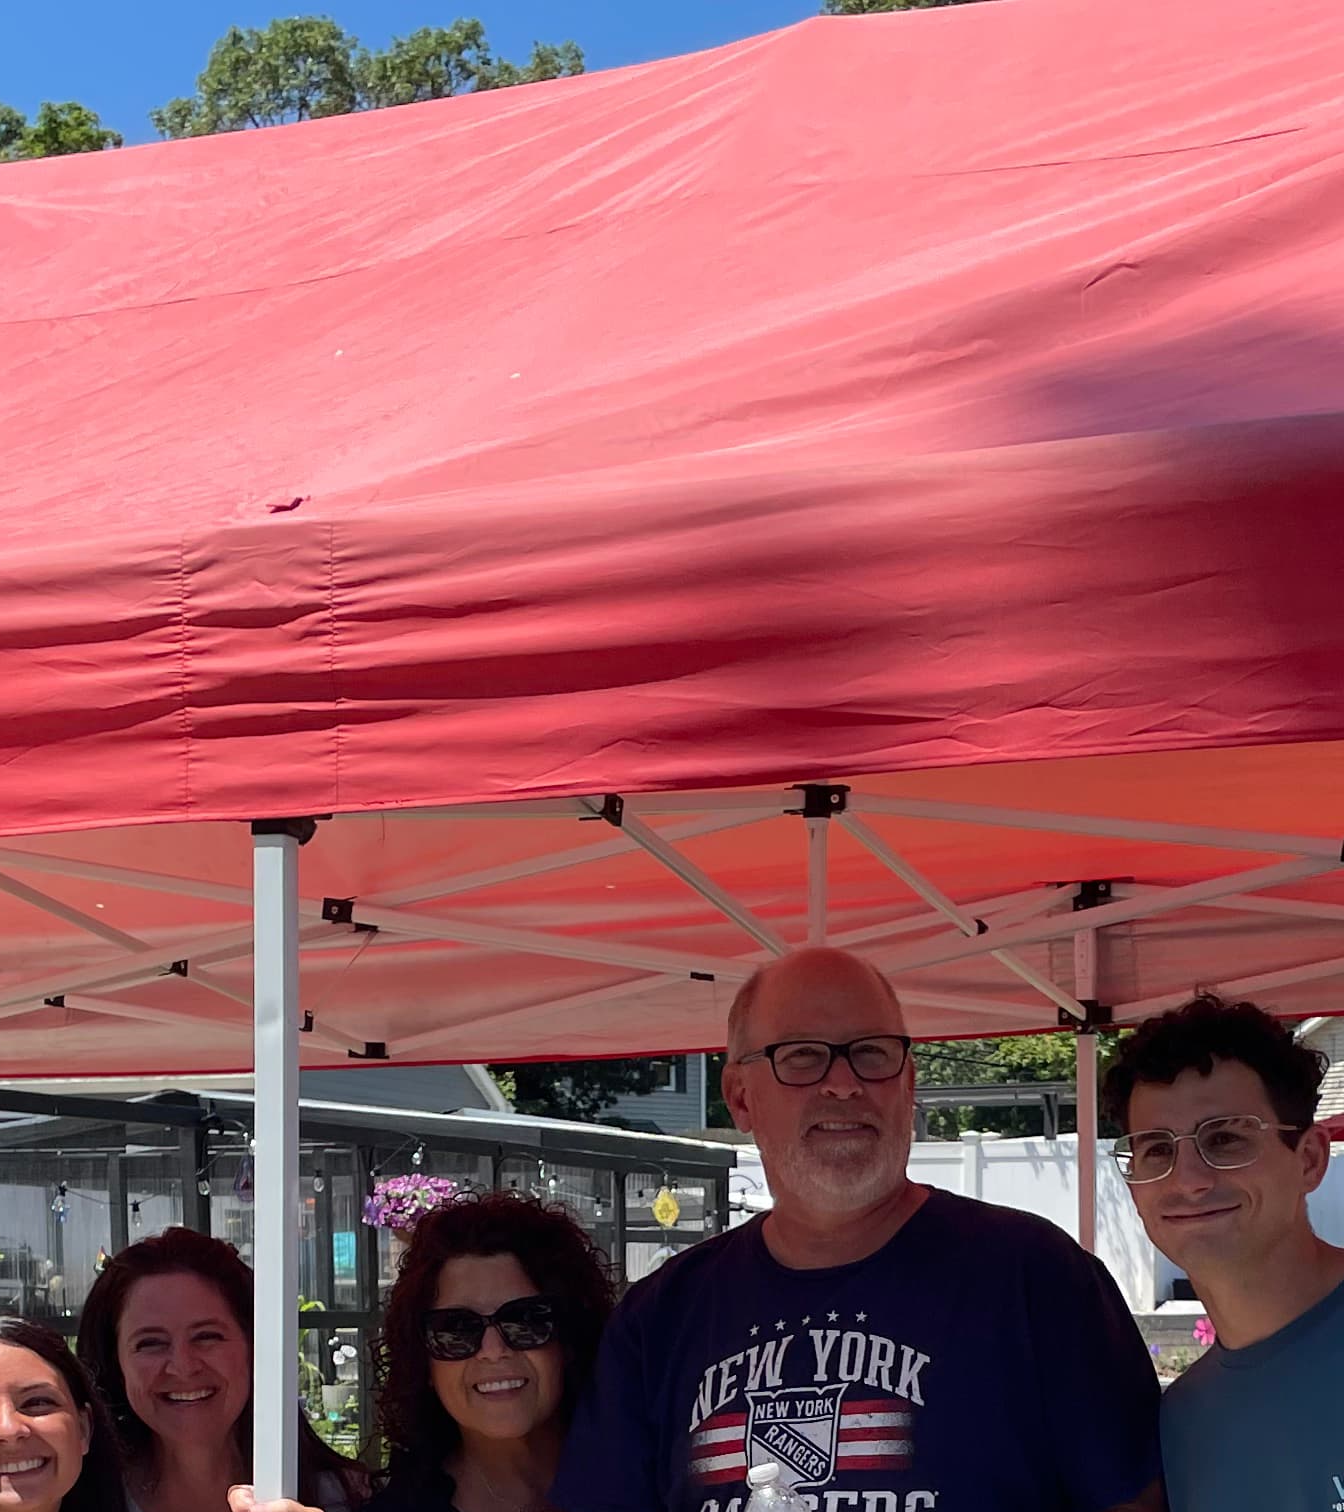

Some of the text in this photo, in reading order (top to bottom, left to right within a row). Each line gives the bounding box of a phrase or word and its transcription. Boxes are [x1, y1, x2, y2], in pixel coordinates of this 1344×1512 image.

[689, 1329, 931, 1433] NEW YORK
[754, 1397, 834, 1419] NEW YORK
[764, 1424, 826, 1477] RANGERS
